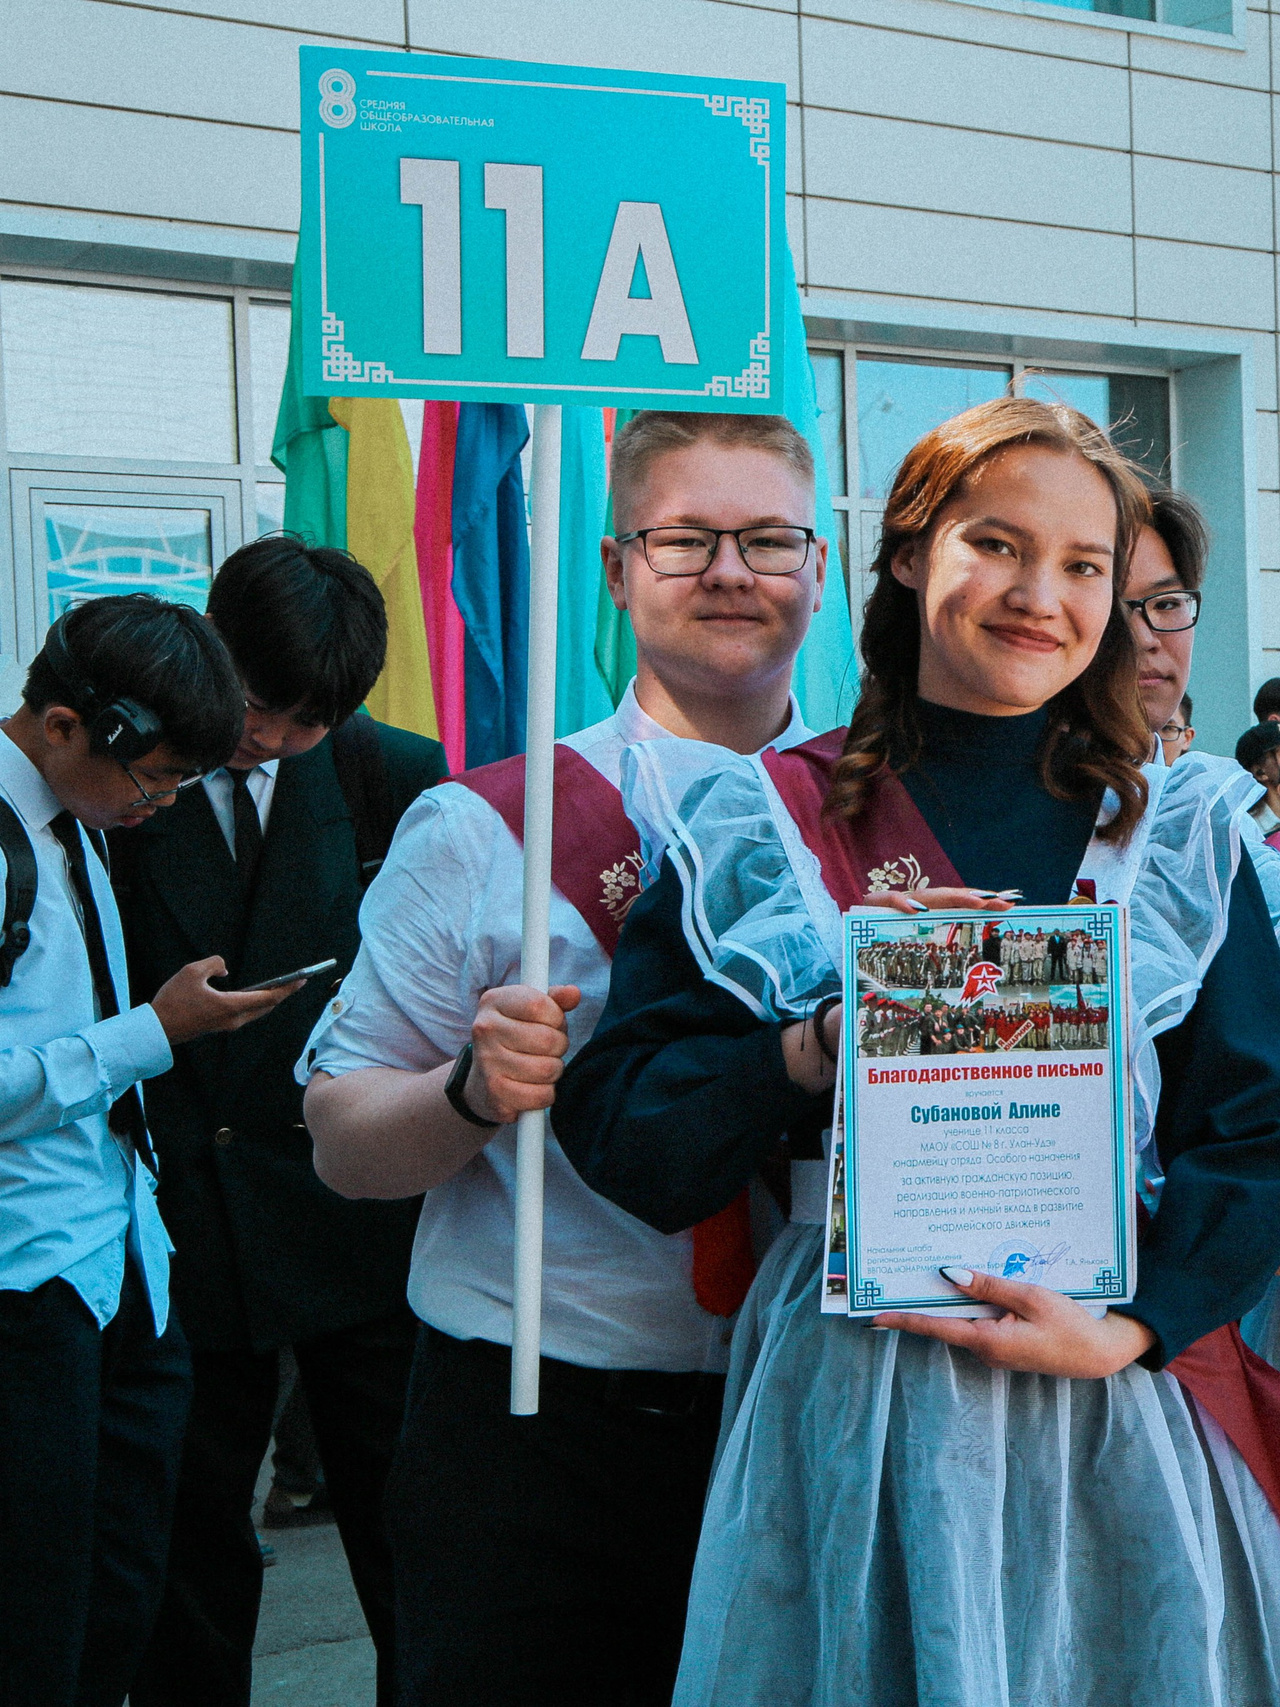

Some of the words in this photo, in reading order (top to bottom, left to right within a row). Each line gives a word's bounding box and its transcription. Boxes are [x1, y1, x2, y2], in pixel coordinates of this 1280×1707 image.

[359, 99, 405, 111] СРЕДНЯЯ
[359, 110, 495, 128] ОБЩЕОБРАЗОВАТЕЛЬНАЯ
[359, 122, 403, 133] ШКОЛА
[399, 157, 545, 359] 11
[580, 201, 700, 365] А
[868, 1065, 1033, 1084] Благодарственное
[1037, 1062, 1104, 1077] письмо
[965, 1089, 1004, 1099] вручается
[911, 1102, 1002, 1125] Субановой
[1009, 1102, 1061, 1119] Алине
[943, 1128, 981, 1138] ученице
[984, 1125, 994, 1135] 11
[996, 1125, 1029, 1135] класса
[920, 1141, 949, 1152] МАОУ
[993, 1140, 999, 1150] 8
[893, 1155, 948, 1169] юнармейцу
[950, 1154, 981, 1167] отряда
[986, 1153, 1027, 1165] Особого
[1029, 1152, 1081, 1163] назначения
[901, 1176, 912, 1186] за
[914, 1174, 959, 1187] активную
[961, 1172, 1027, 1185] гражданскую
[896, 1190, 958, 1205] реализацию
[960, 1185, 1080, 1200] военно-патриотического
[893, 1206, 957, 1219] направления
[959, 1207, 965, 1215] и
[968, 1203, 1001, 1216] личный
[1004, 1204, 1031, 1214] вклад
[1040, 1201, 1084, 1214] развитие
[928, 1218, 1002, 1233] юнармейского
[1004, 1218, 1051, 1230] движения
